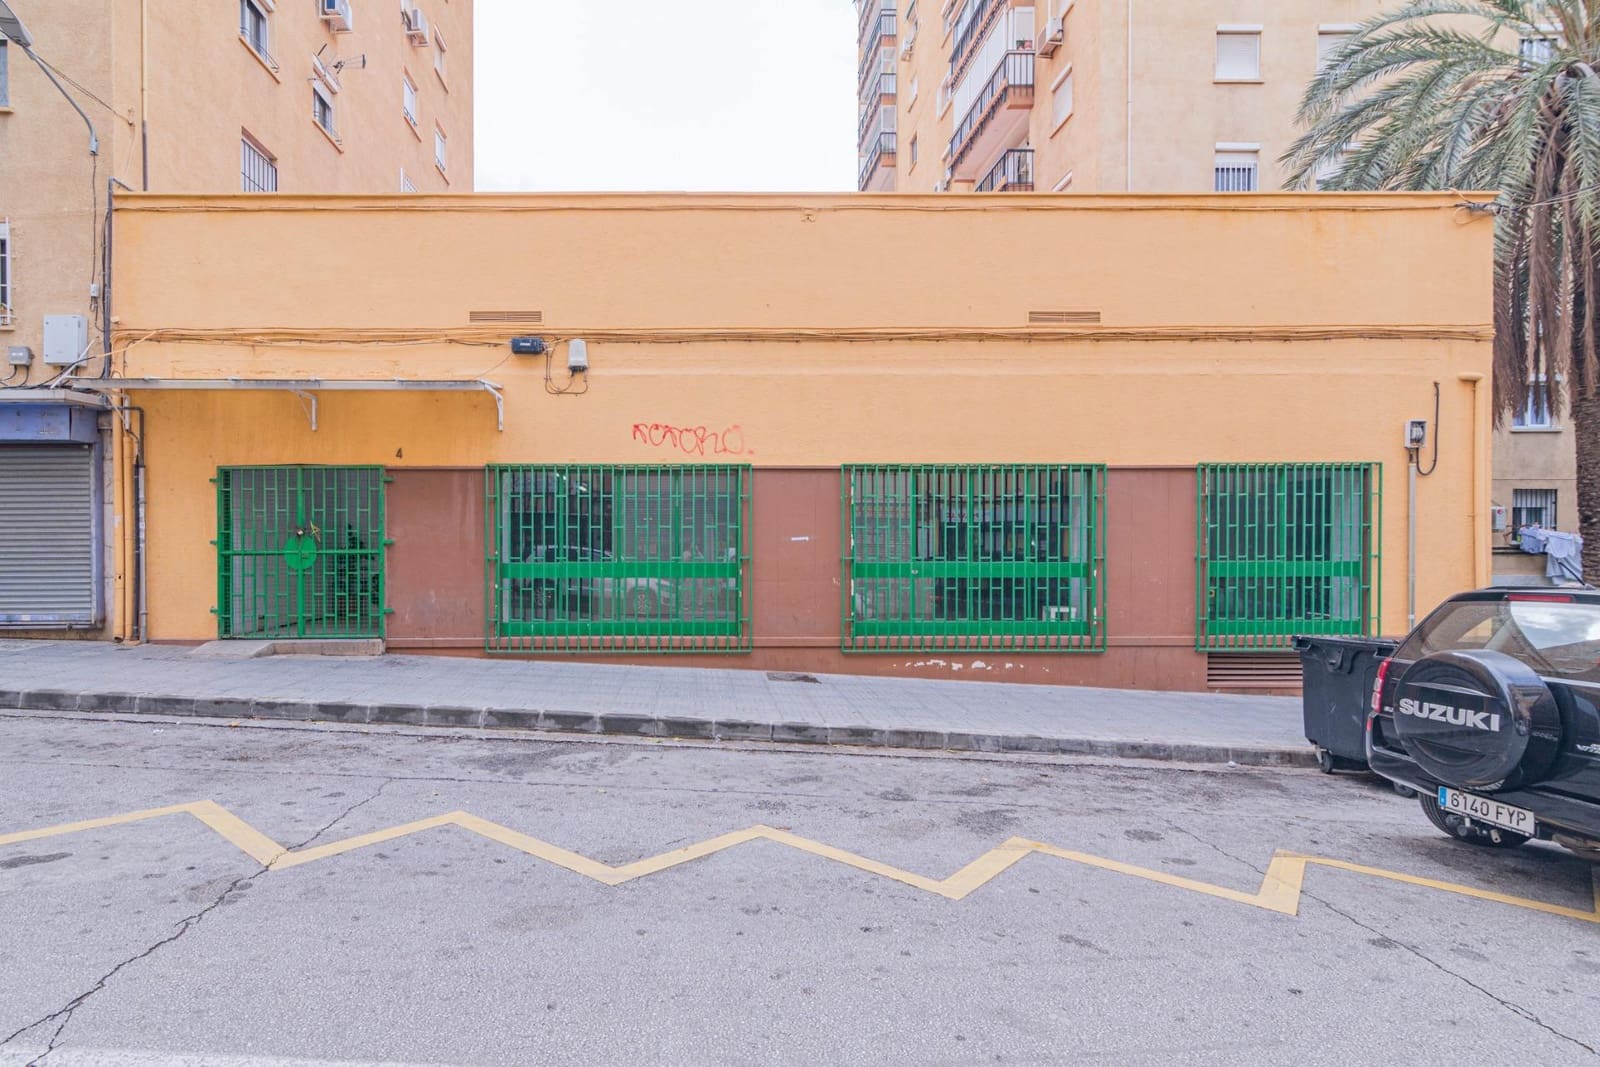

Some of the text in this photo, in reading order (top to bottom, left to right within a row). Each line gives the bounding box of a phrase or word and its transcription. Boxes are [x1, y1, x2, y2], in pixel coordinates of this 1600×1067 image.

[395, 447, 403, 460] 4
[1398, 698, 1501, 732] SUZUKI
[1450, 792, 1527, 827] 6140 FYP
